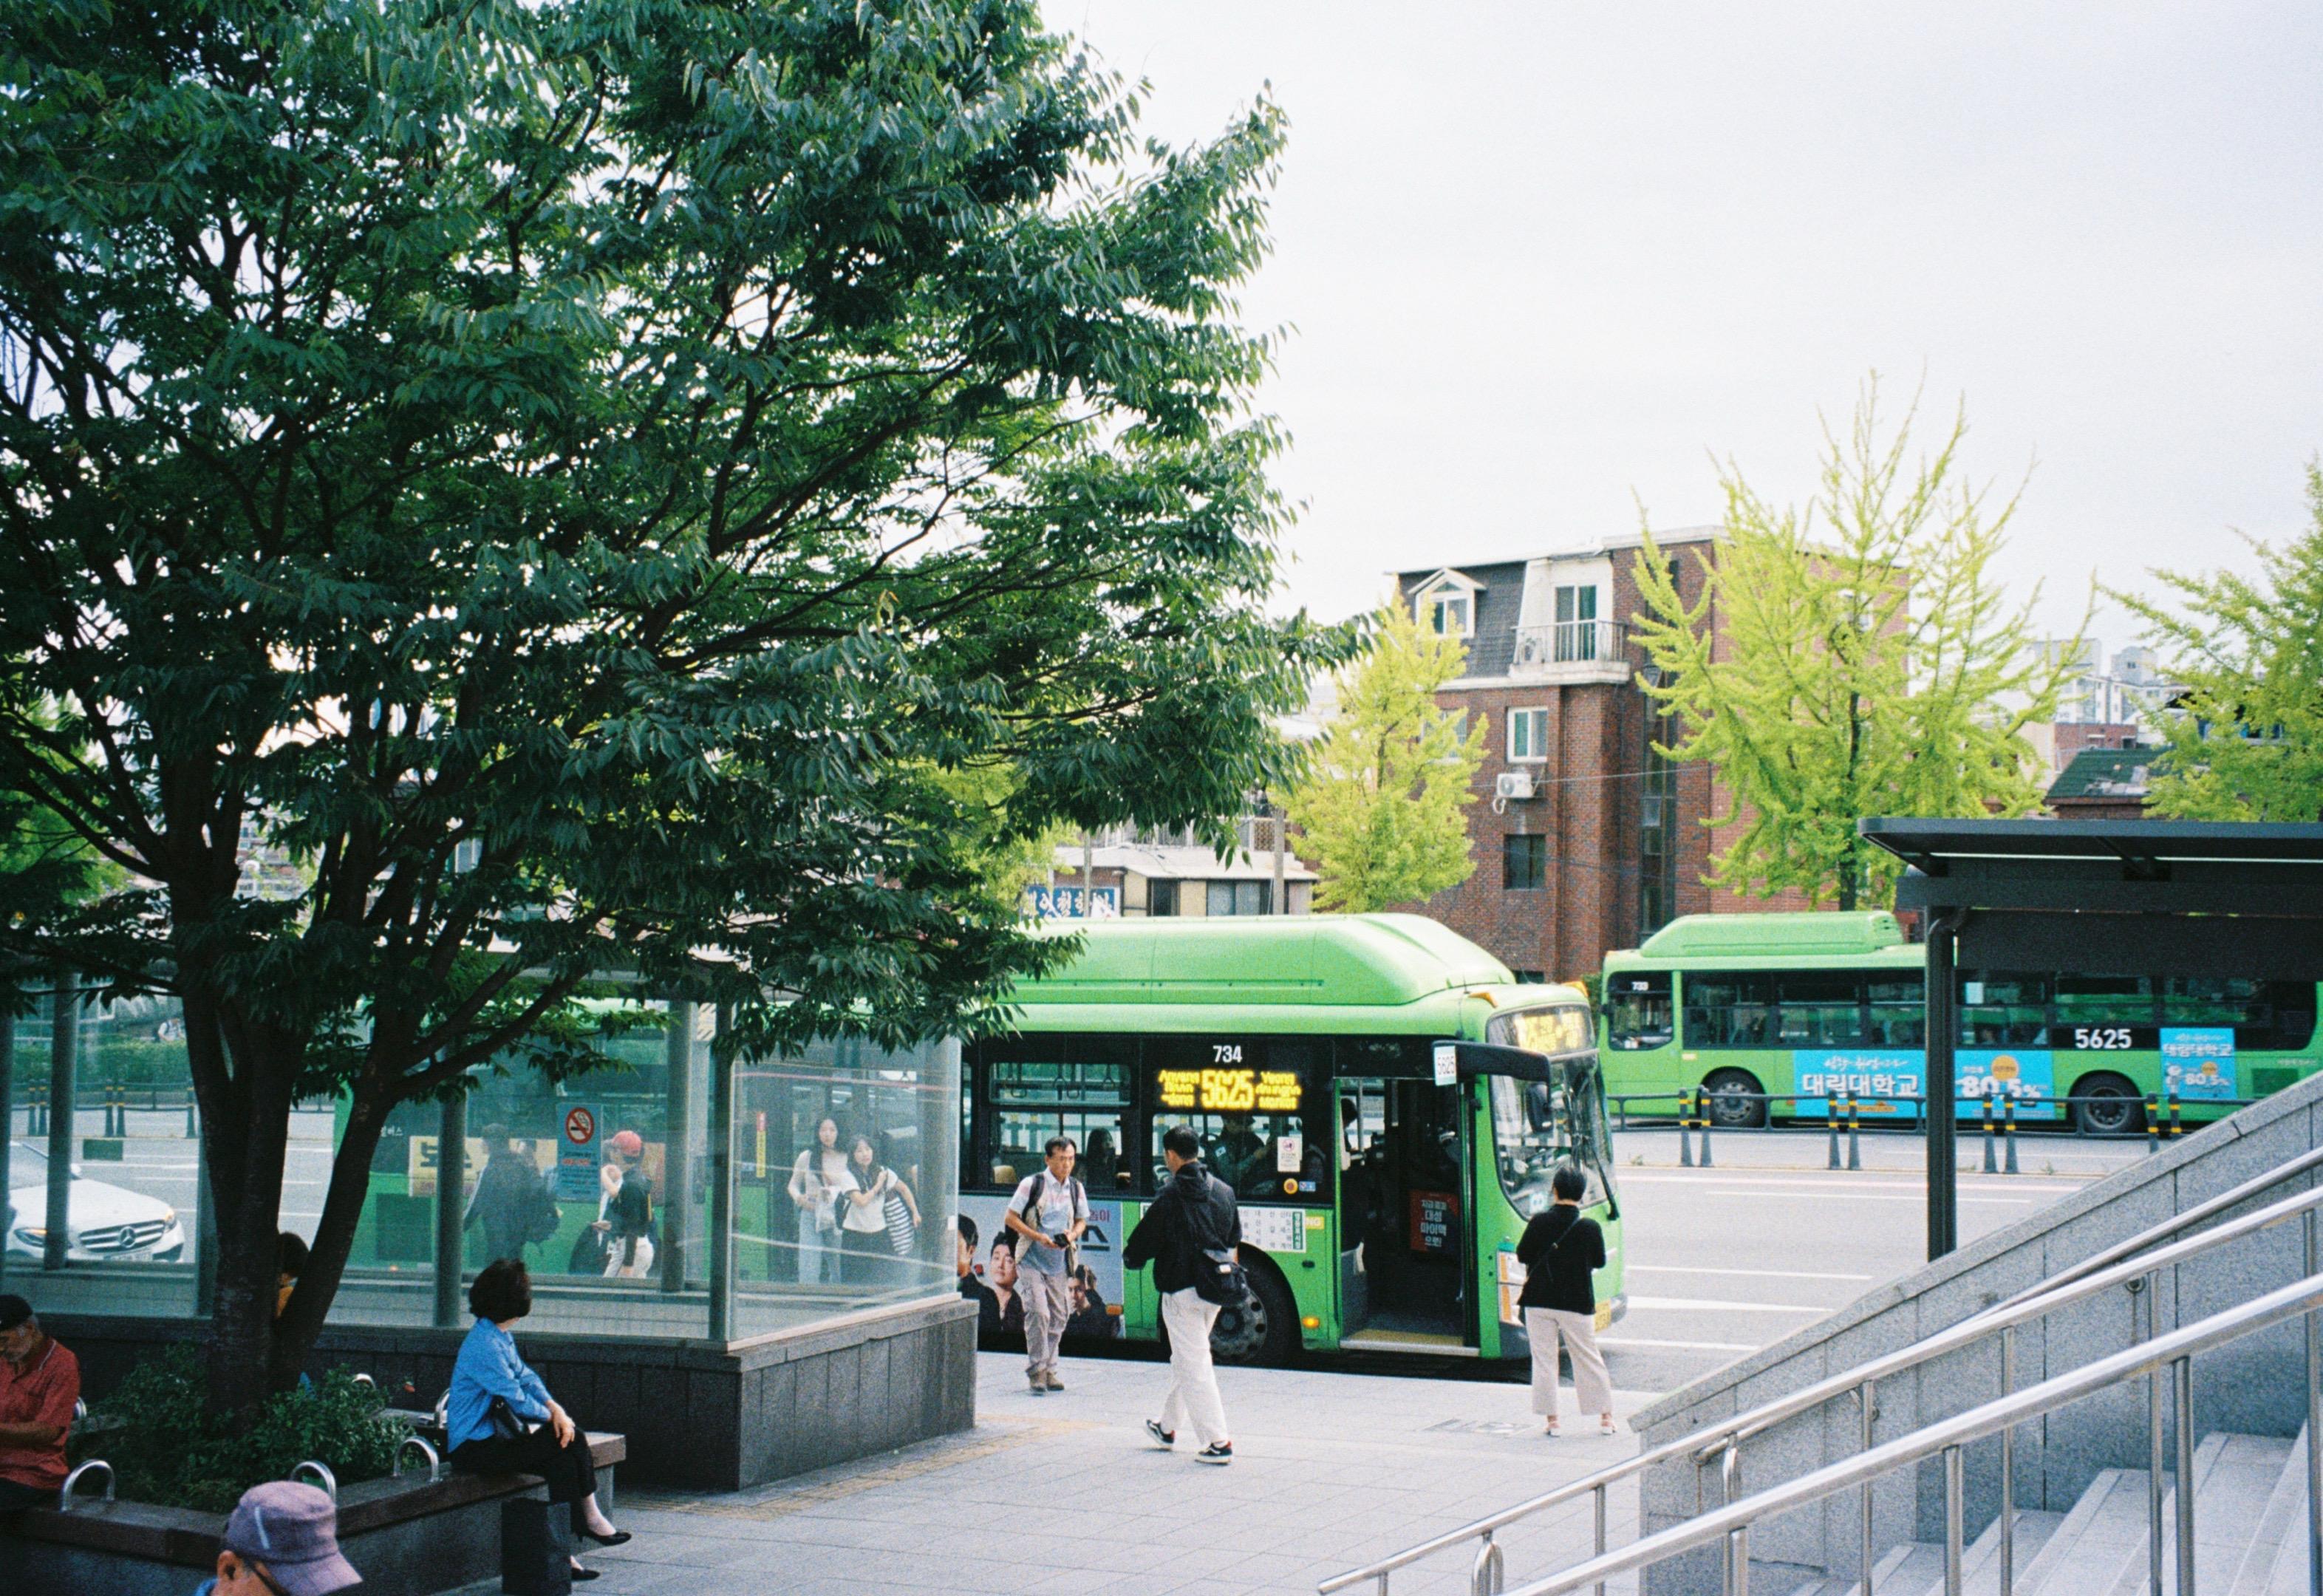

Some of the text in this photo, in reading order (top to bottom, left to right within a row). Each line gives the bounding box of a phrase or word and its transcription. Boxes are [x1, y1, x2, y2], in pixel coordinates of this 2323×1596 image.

[2075, 1029, 2132, 1049] 5625
[1213, 1045, 1242, 1063] 734
[1437, 1056, 1455, 1074] 5625
[1201, 1070, 1255, 1109] 5625
[1802, 1074, 1919, 1098] 대림대학교
[1076, 1225, 1110, 1252] 스
